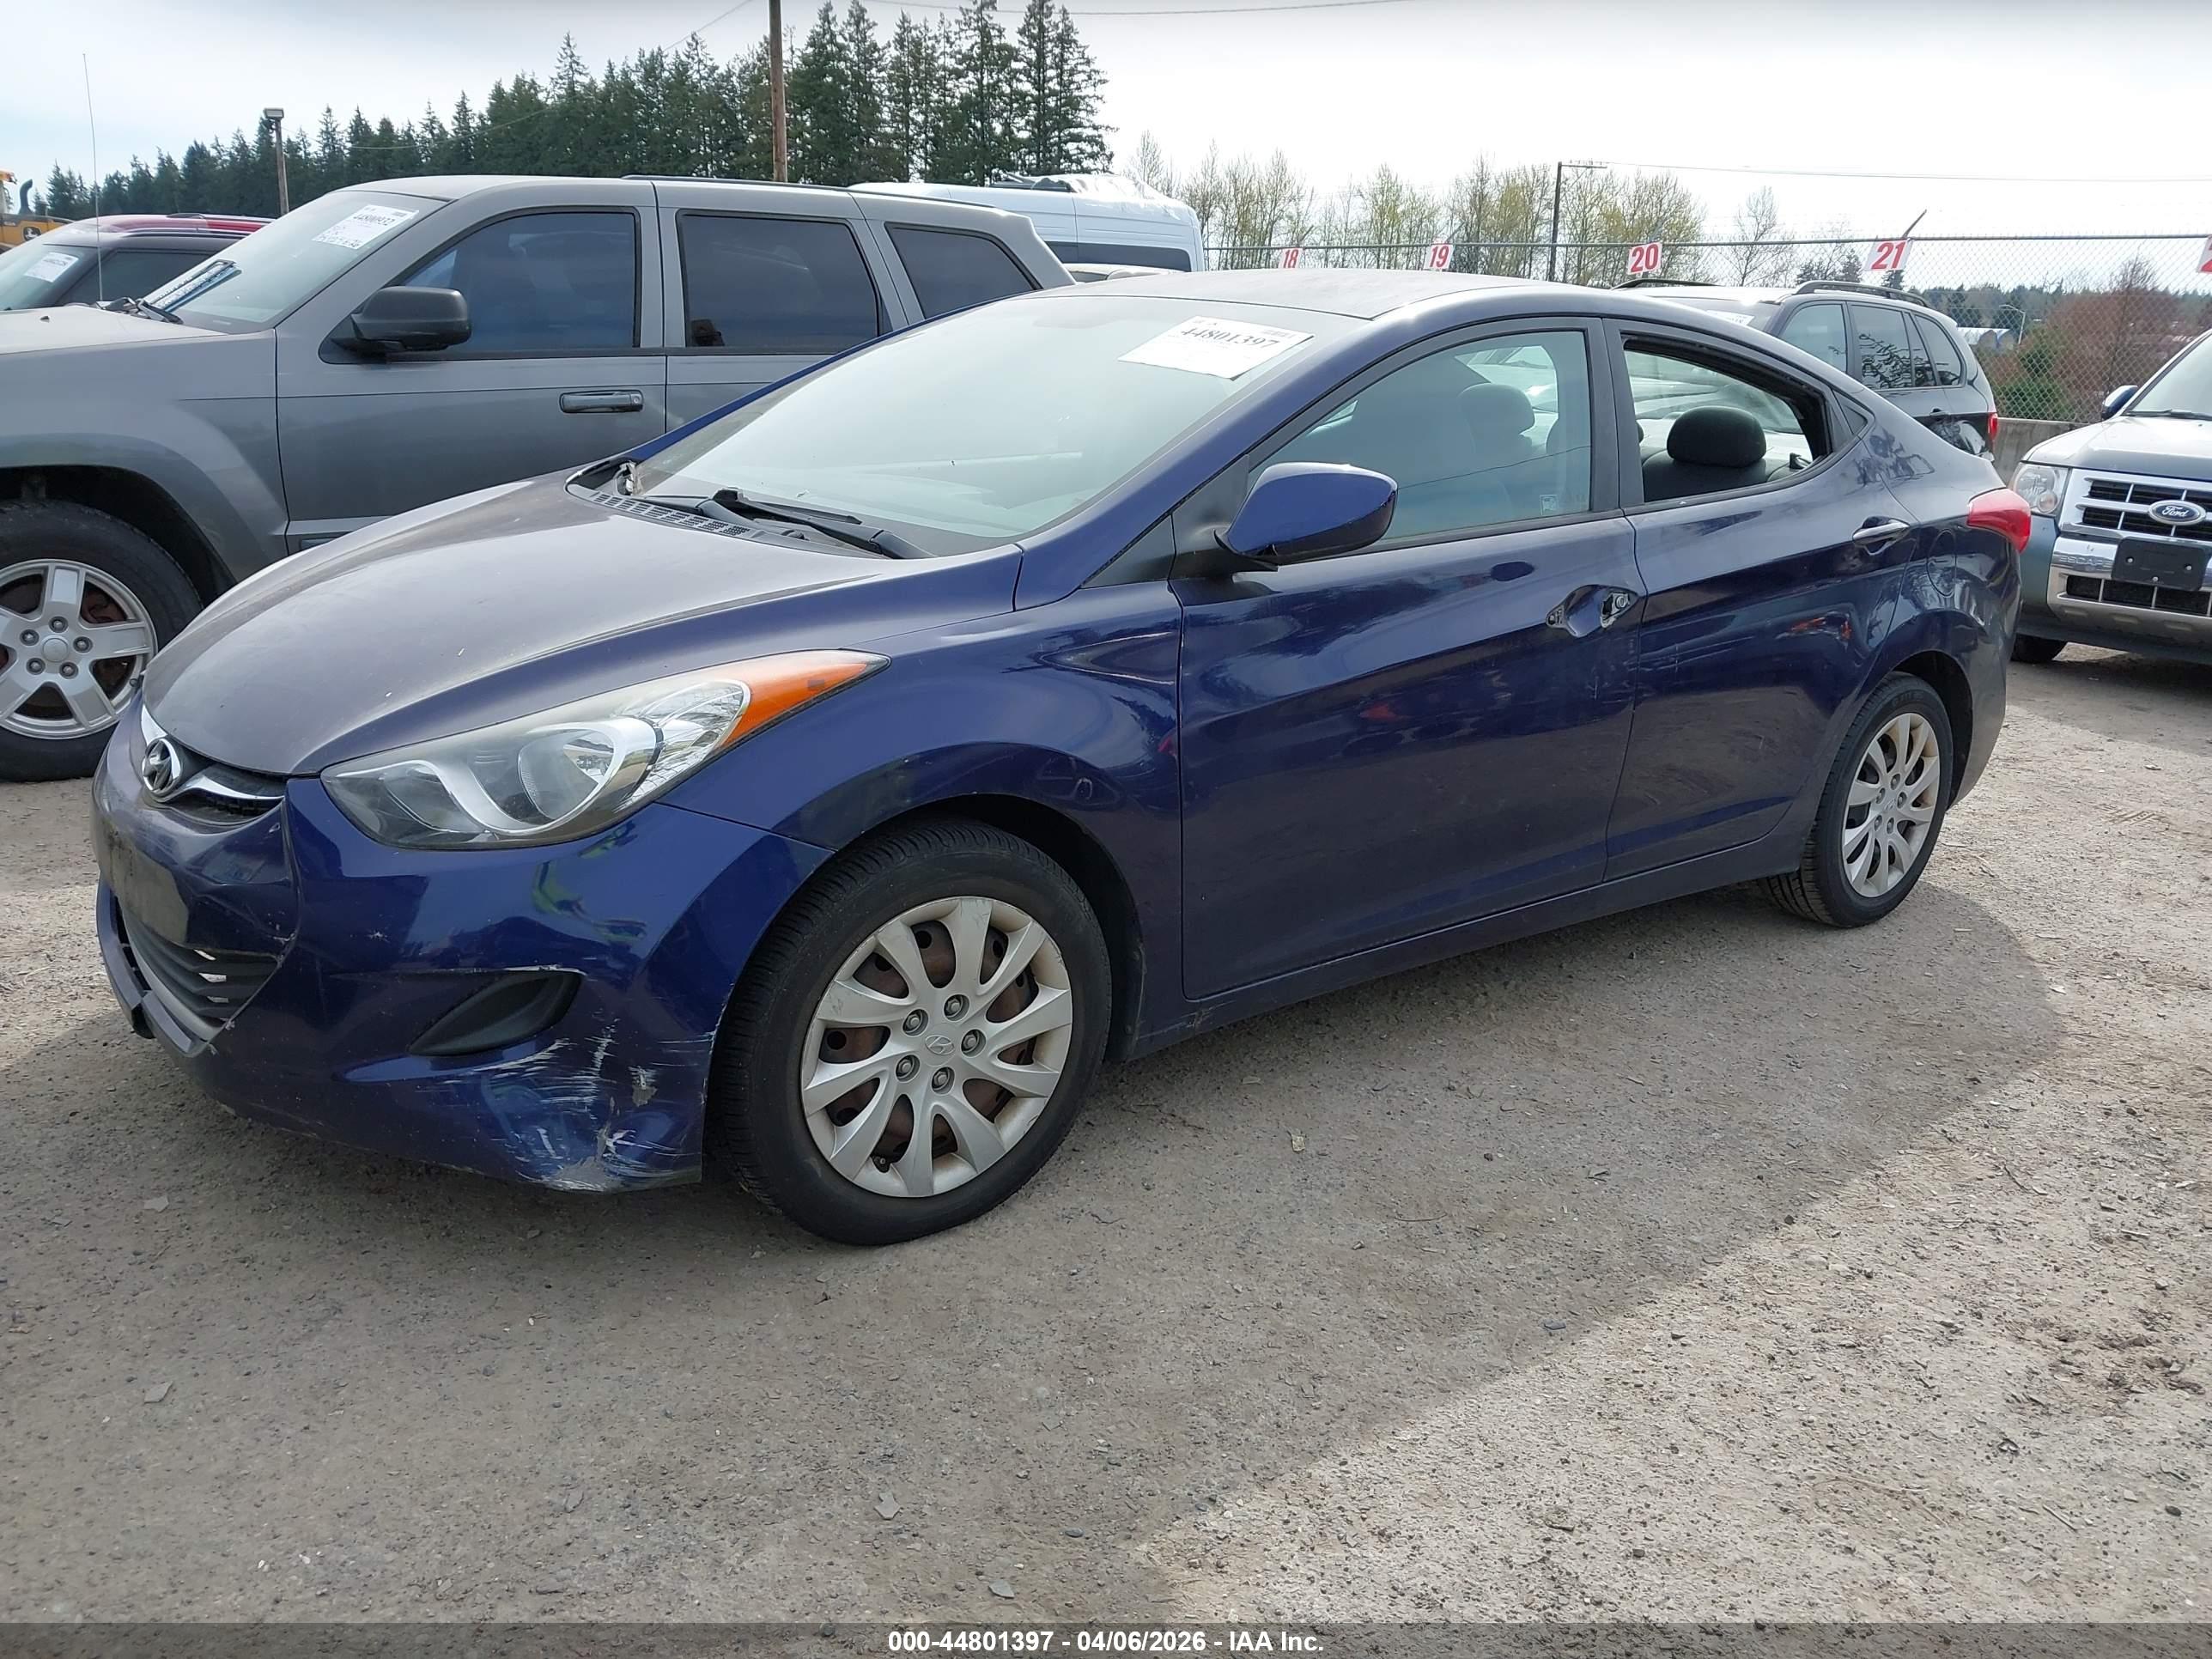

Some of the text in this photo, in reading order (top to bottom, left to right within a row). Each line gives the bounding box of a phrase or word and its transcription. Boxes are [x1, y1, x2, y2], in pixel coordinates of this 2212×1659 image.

[1283, 249, 1299, 268] 18
[1429, 246, 1449, 268] 19
[1630, 243, 1659, 273] 20
[1870, 241, 1907, 270] 21
[1181, 326, 1281, 349] 44801397
[2160, 505, 2191, 518] Ford
